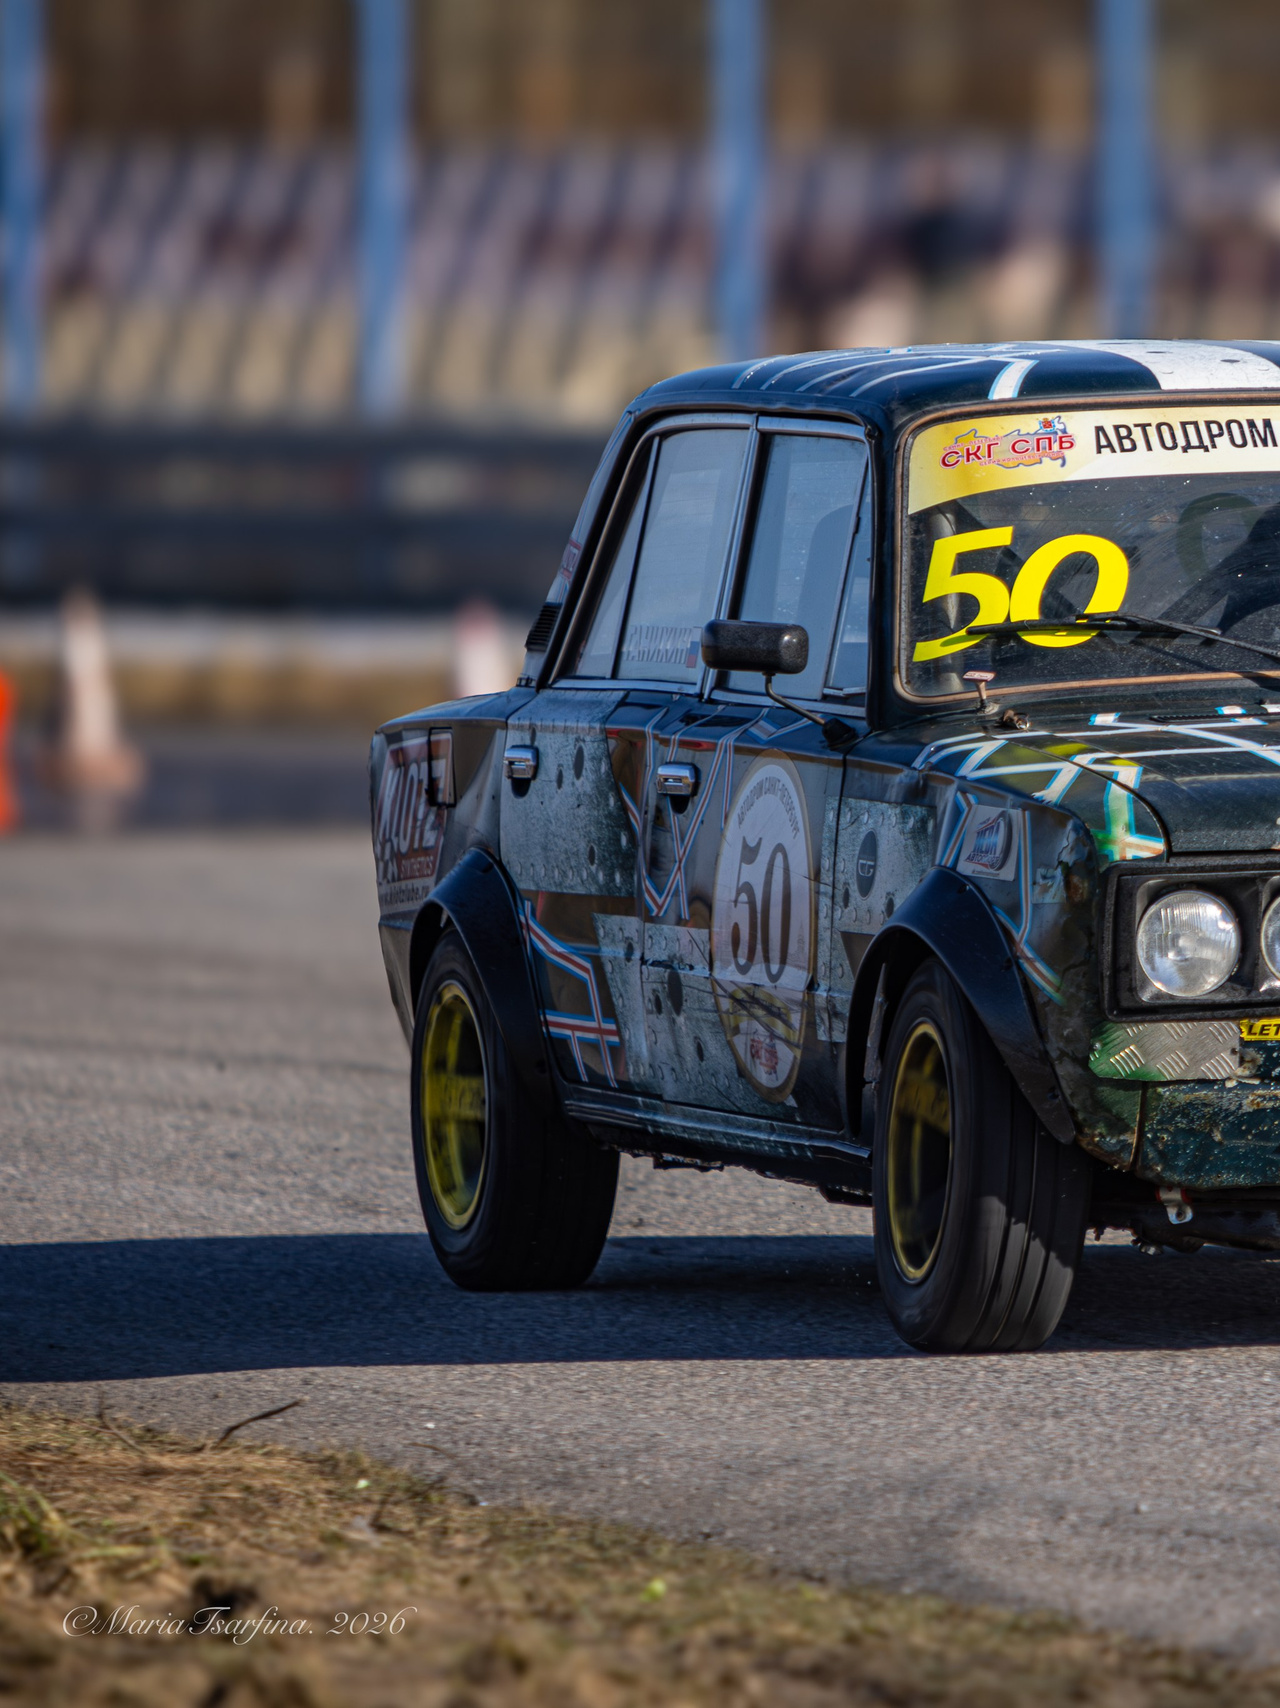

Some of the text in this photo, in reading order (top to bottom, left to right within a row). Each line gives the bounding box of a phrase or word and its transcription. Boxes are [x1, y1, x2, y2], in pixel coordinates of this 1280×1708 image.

[940, 434, 1075, 468] СКГ СПБ
[1094, 418, 1279, 454] АВТОДРОМ
[912, 525, 1129, 662] 50
[377, 757, 447, 855] KLOTZ
[731, 835, 791, 984] 50
